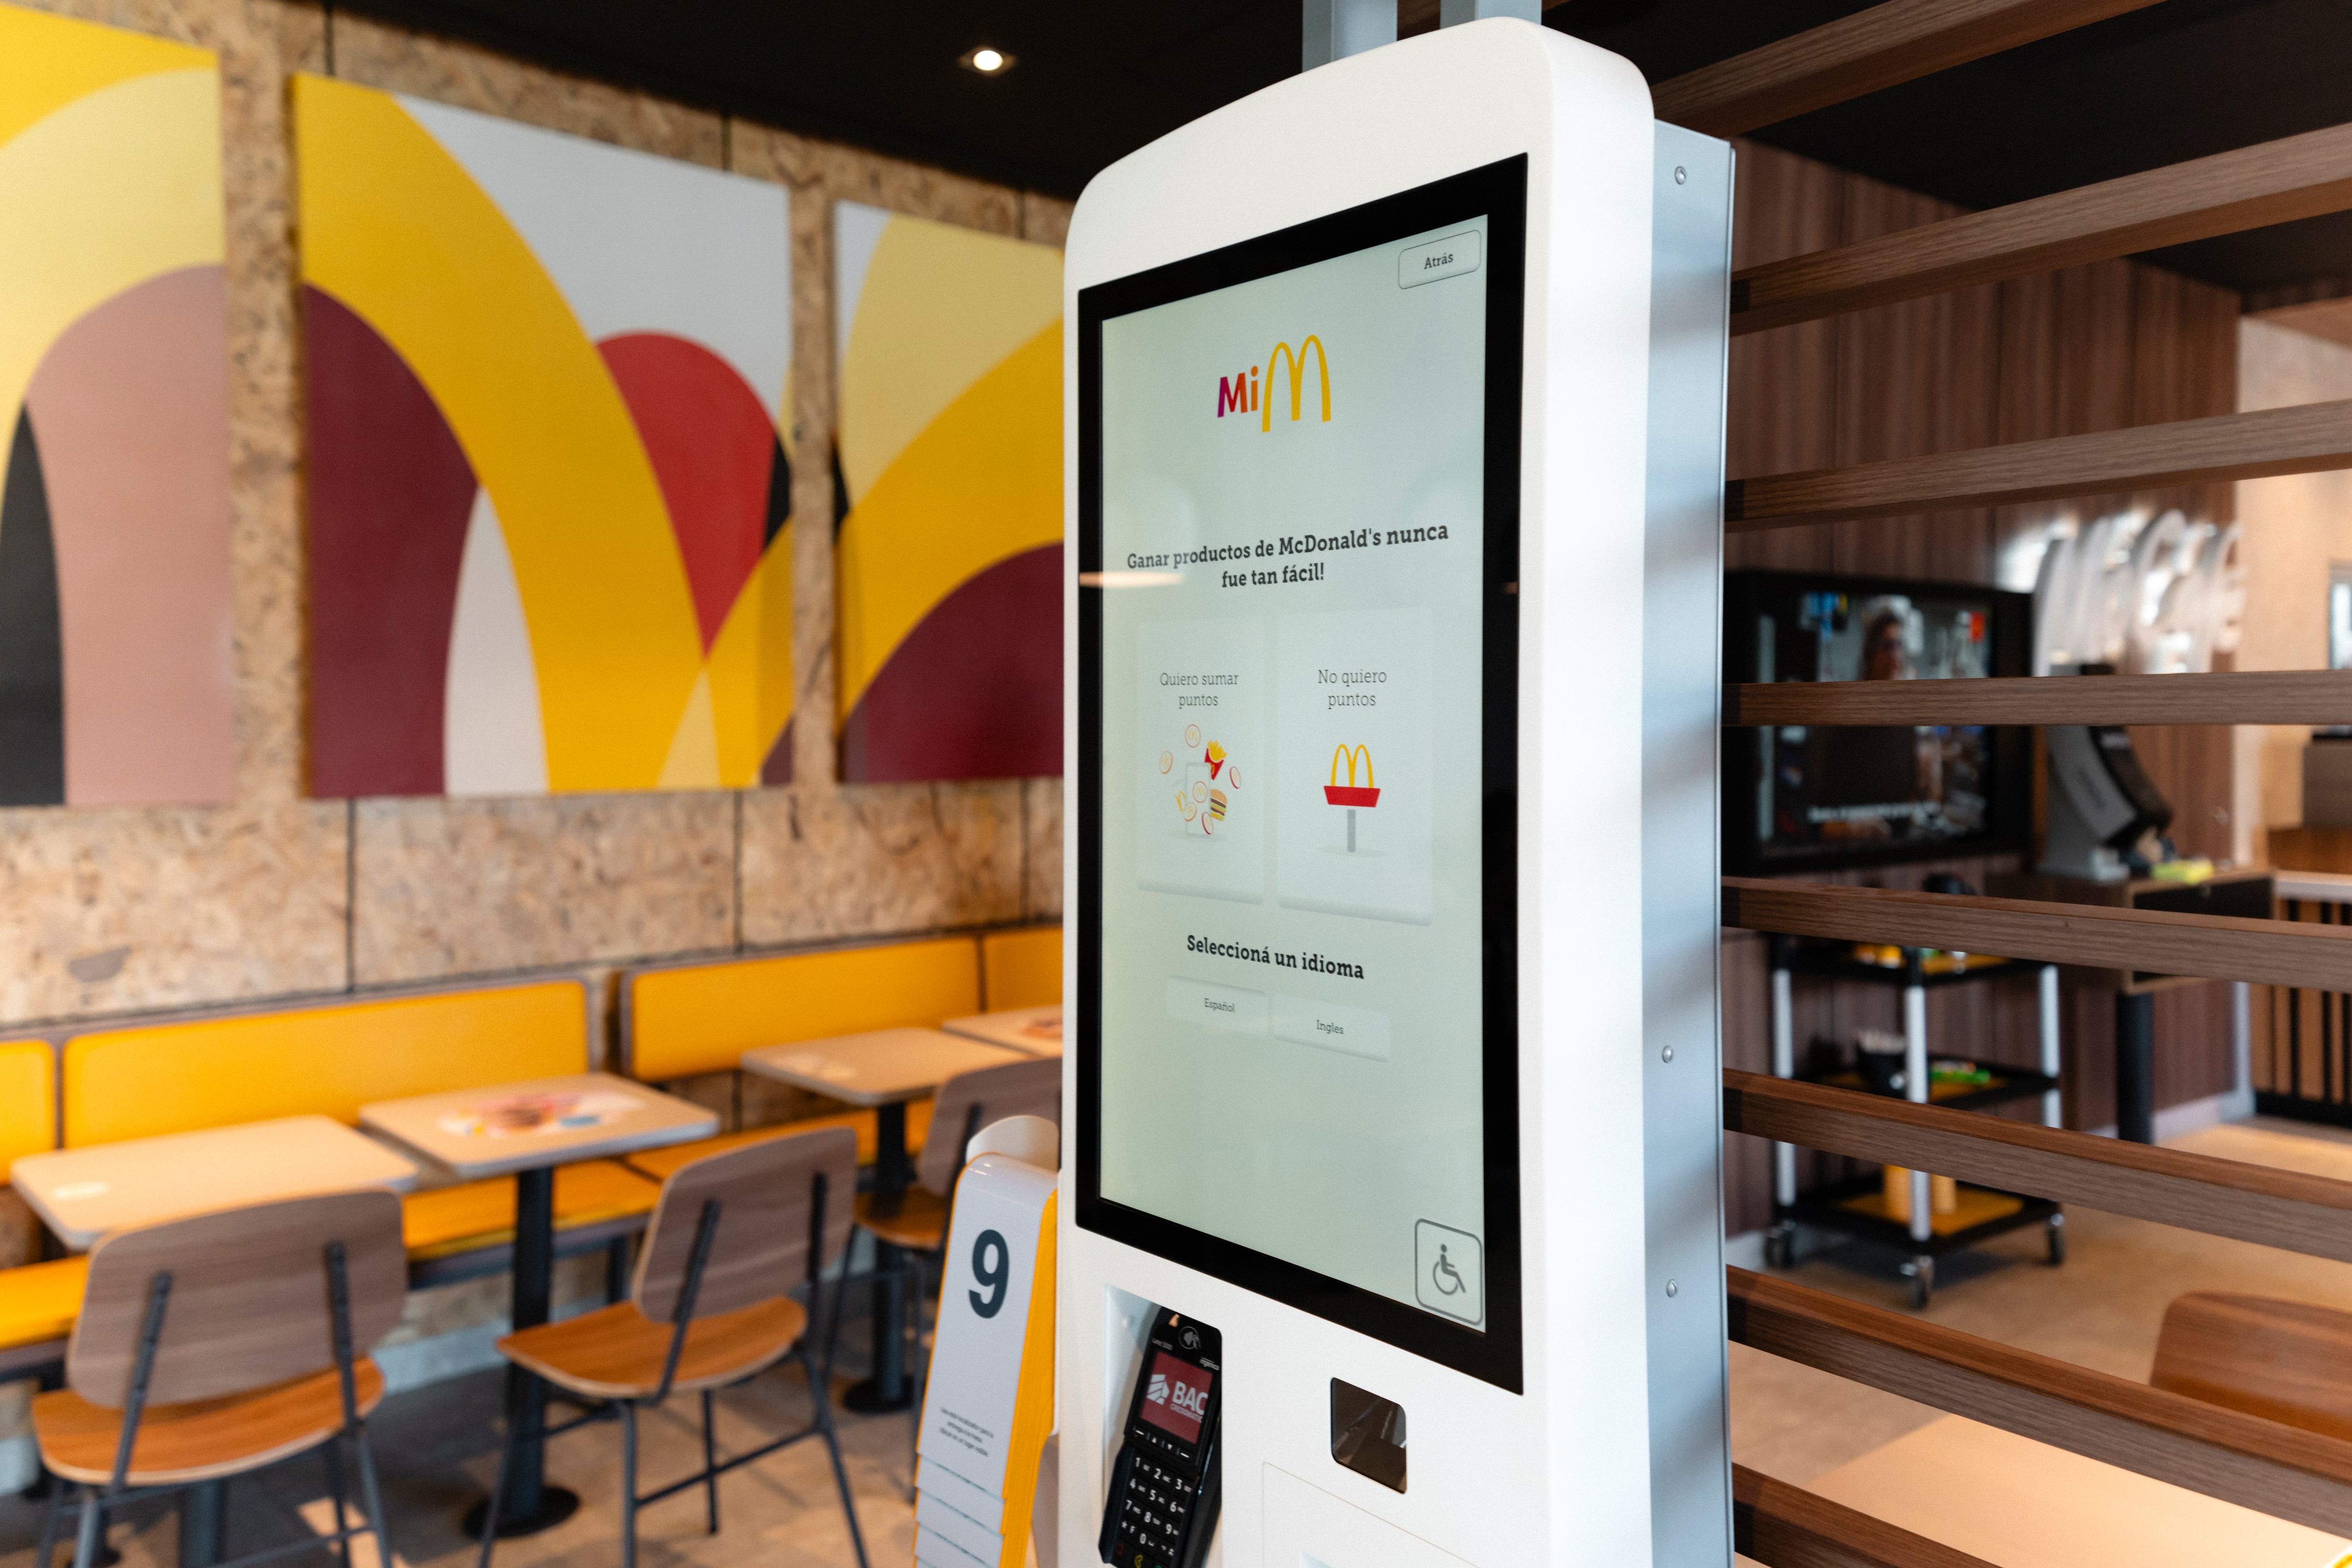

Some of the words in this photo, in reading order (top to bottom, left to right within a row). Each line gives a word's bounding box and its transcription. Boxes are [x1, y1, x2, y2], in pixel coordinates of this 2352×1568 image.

[1424, 252, 1454, 270] Atrás
[1217, 366, 1259, 418] Mi
[1128, 553, 1169, 569] Ganar
[1173, 545, 1251, 569] productos
[1255, 540, 1274, 557] de
[1279, 528, 1382, 555] McDonald's
[1386, 525, 1449, 545] nunca
[1222, 571, 1247, 588] fue
[1251, 570, 1278, 585] tan
[1282, 562, 1325, 583] fácil!
[1159, 672, 1199, 685] Quiero
[1201, 673, 1239, 685] sumar
[1317, 669, 1338, 684] No
[1341, 669, 1387, 687] quiero
[1178, 694, 1219, 709] puntos
[1328, 692, 1376, 709] puntos
[1187, 934, 1271, 964] Seleccioná
[1274, 952, 1297, 968] un
[1302, 952, 1365, 979] idioma
[1204, 997, 1236, 1012] Español
[1316, 1019, 1344, 1035] Ingles
[968, 1229, 1010, 1319] 9
[1172, 1380, 1209, 1416] BAC
[1135, 1457, 1141, 1468] 1
[1154, 1468, 1161, 1480] 2
[1175, 1478, 1183, 1490] 3
[1129, 1478, 1136, 1489] 4
[1149, 1489, 1157, 1501] 5
[1170, 1501, 1177, 1512] 6
[1126, 1499, 1132, 1510] 7
[1144, 1511, 1152, 1523] 8
[1166, 1523, 1172, 1535] 9
[1139, 1533, 1146, 1544] 0
